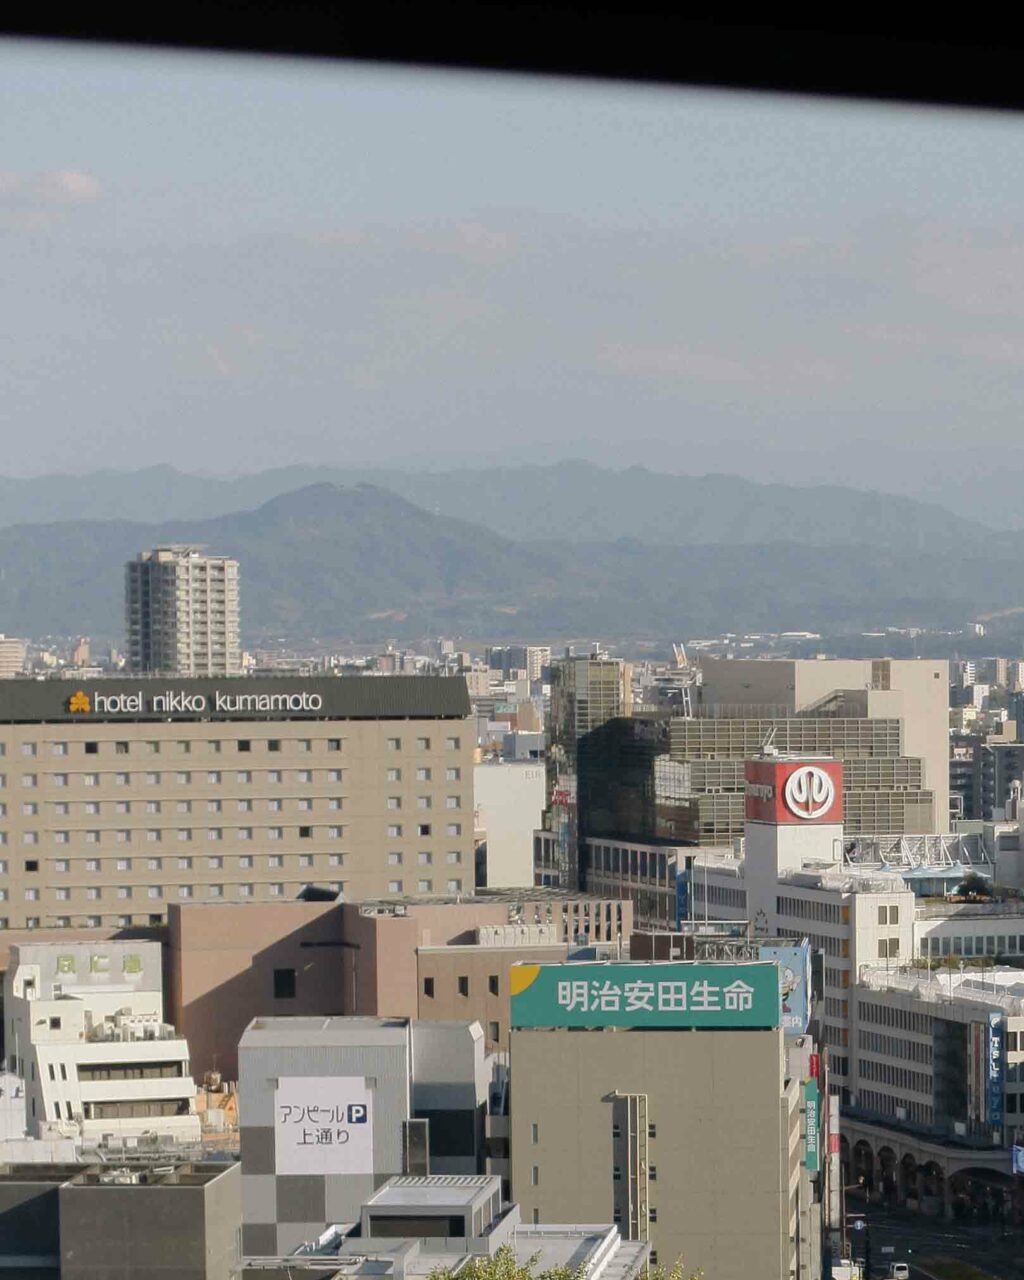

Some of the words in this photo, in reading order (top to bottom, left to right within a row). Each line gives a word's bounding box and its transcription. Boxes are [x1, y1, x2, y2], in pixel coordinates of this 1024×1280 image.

[94, 691, 142, 713] hotel
[153, 691, 206, 712] nikko
[215, 691, 322, 711] kumamoto
[557, 980, 754, 1012] 明治安田生命
[280, 1105, 344, 1123] アンピール
[296, 1128, 349, 1145] 上通り
